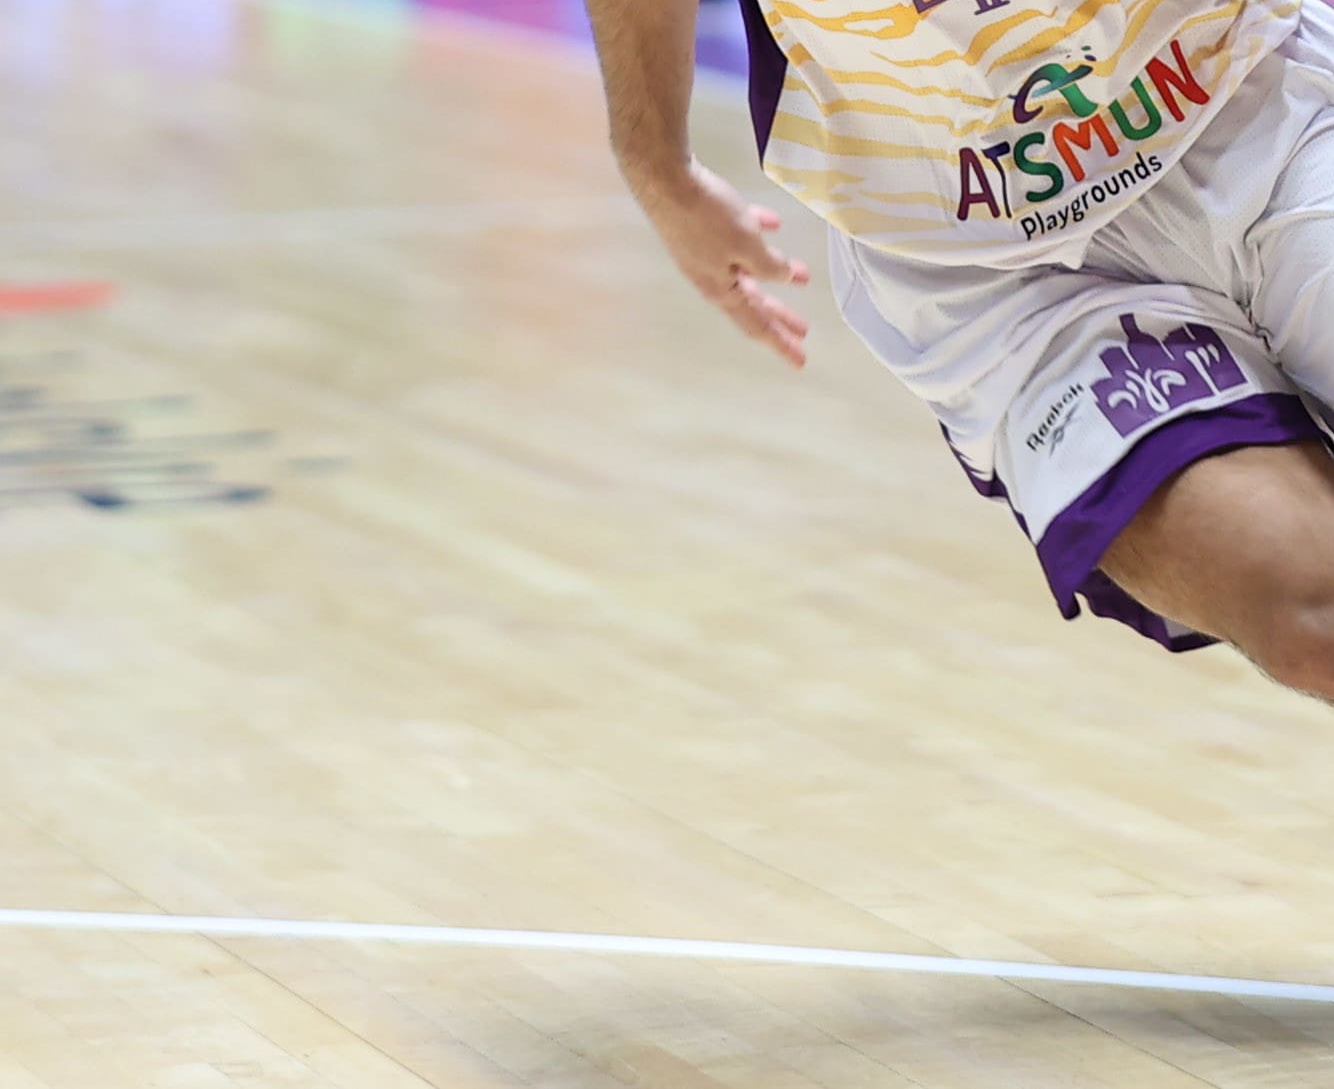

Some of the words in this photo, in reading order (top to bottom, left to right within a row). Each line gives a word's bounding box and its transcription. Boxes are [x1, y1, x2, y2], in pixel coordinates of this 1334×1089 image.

[957, 39, 1210, 221] ATSMUN
[1020, 151, 1163, 241] Playgrounds
[1107, 367, 1187, 414] בעיר
[1184, 343, 1222, 397] יין
